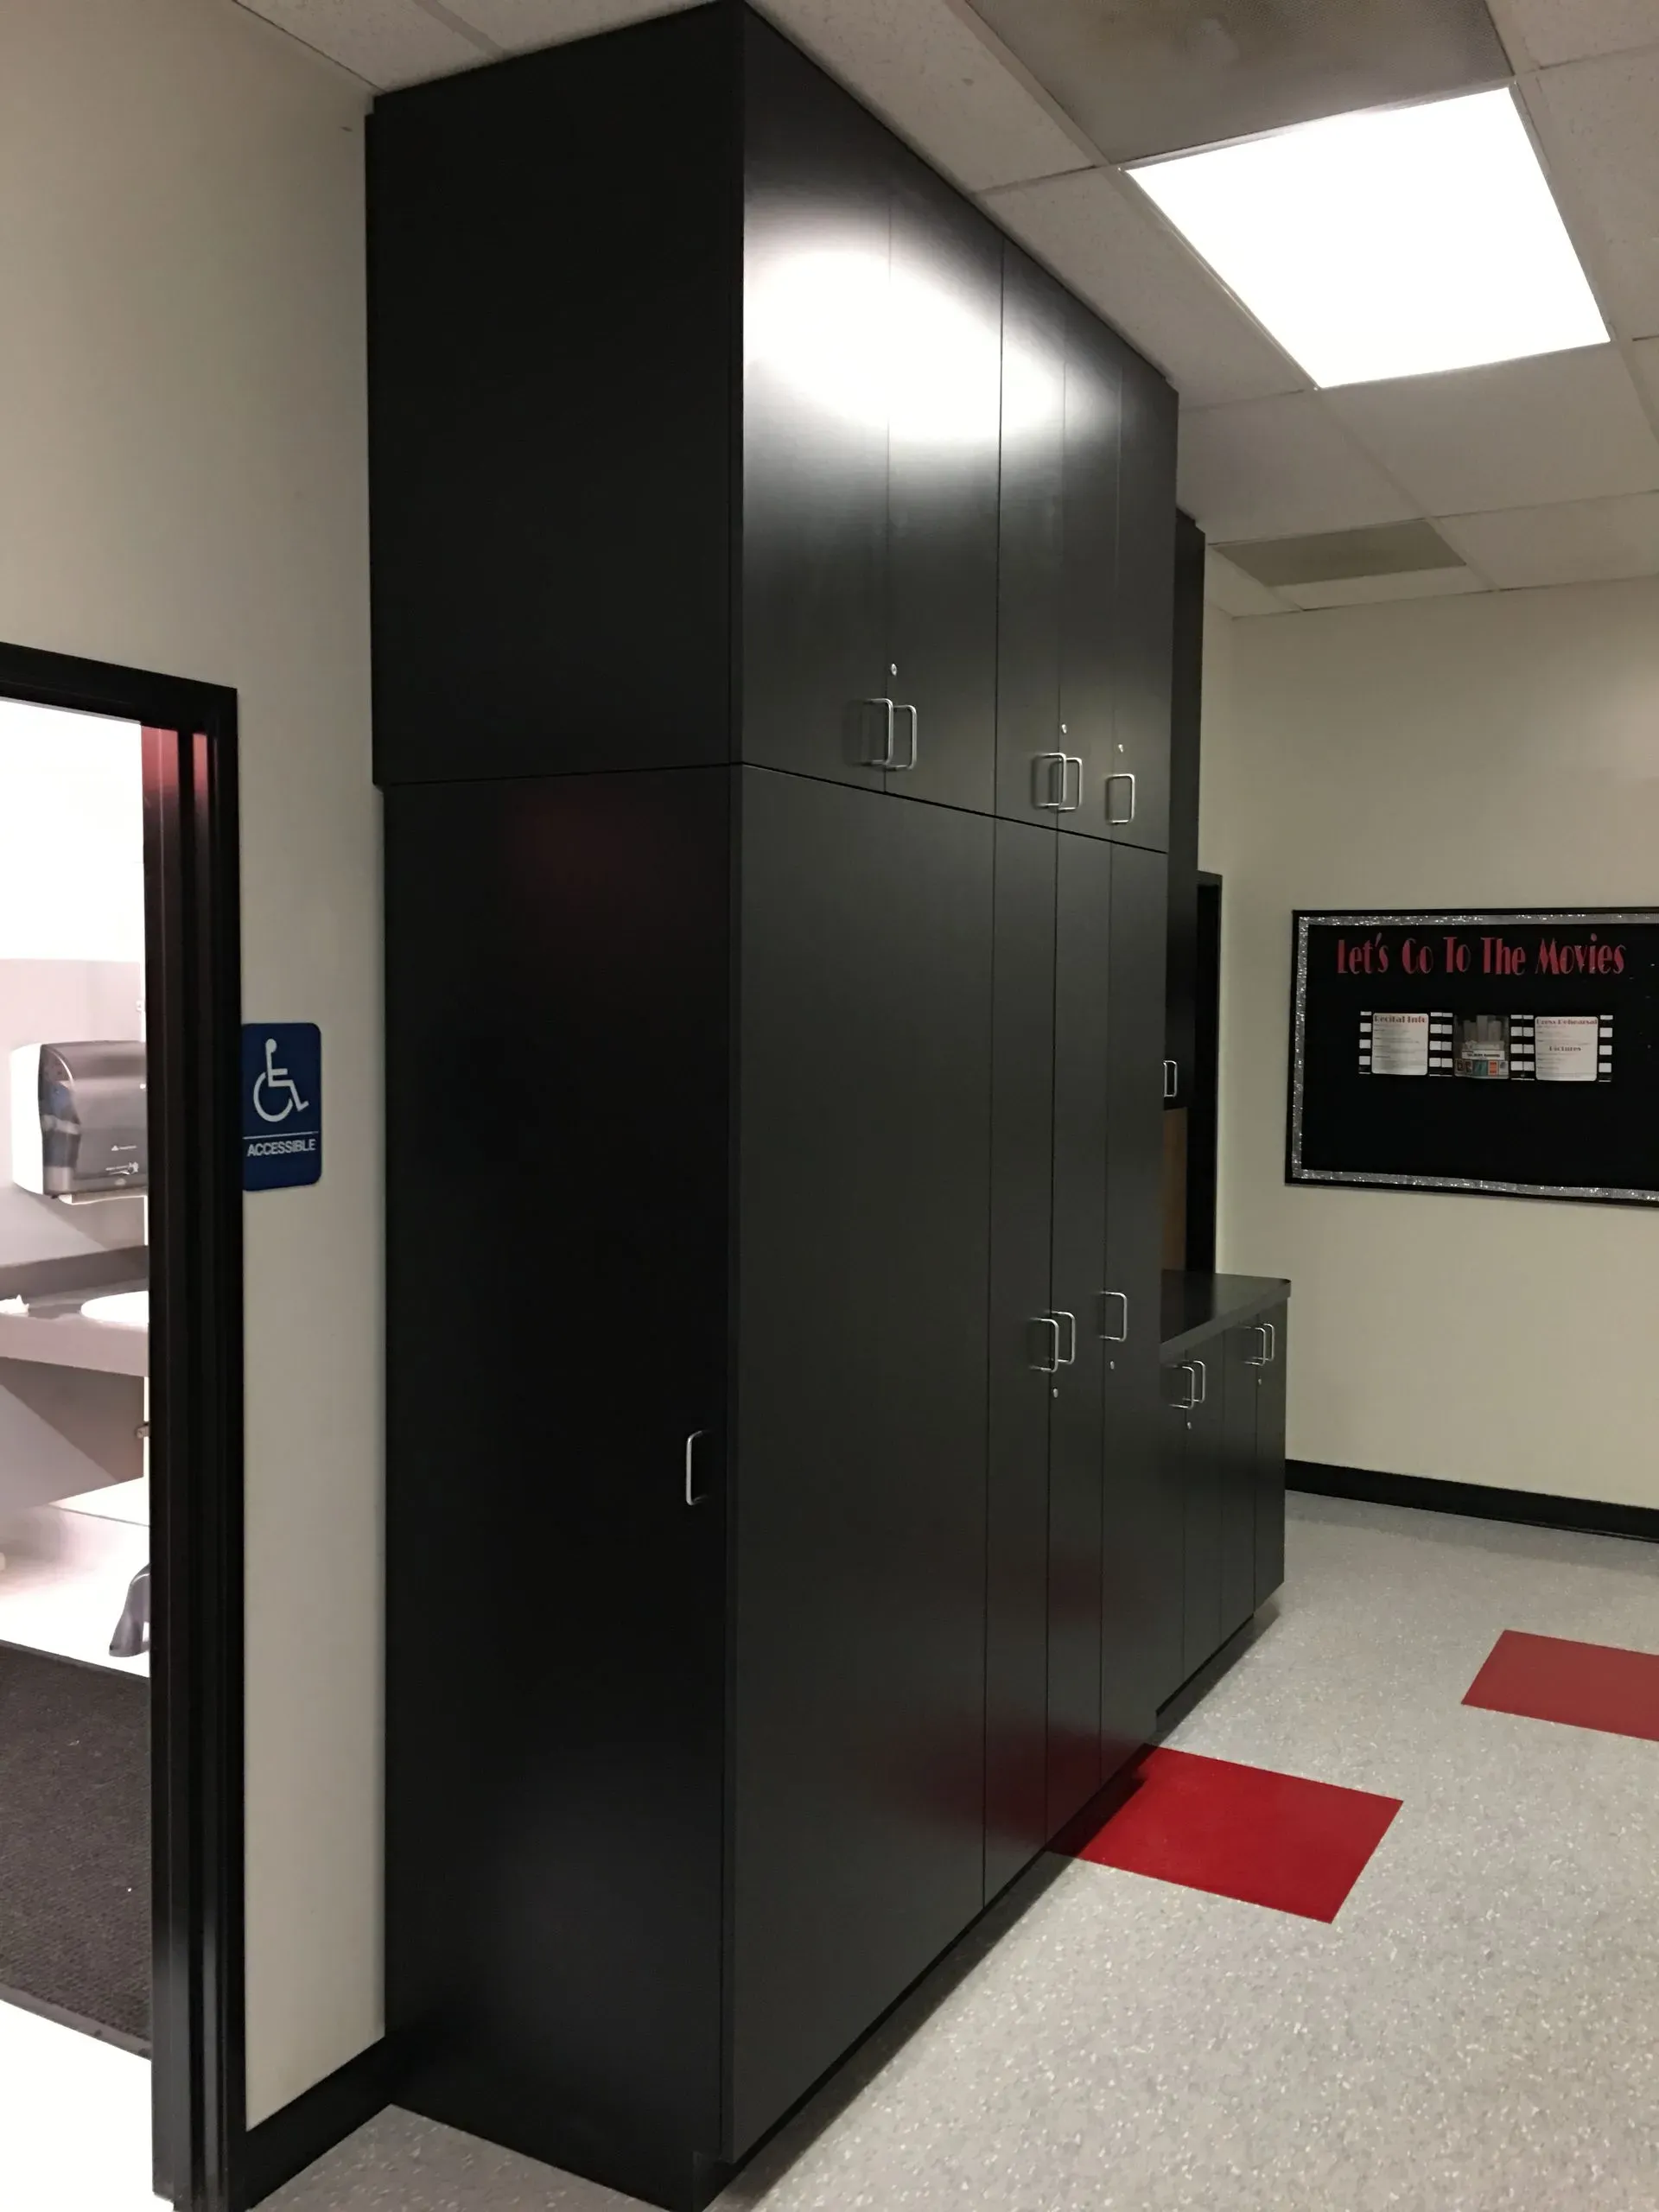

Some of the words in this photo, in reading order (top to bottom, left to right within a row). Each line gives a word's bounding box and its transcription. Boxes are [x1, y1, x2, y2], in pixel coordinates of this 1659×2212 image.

[1337, 932, 1389, 974] Let's
[1402, 938, 1433, 974] Go
[1443, 936, 1471, 973] To
[1480, 937, 1526, 975] The
[1535, 933, 1626, 975] Movies
[1374, 1015, 1405, 1024] Recital
[247, 1139, 316, 1157] ACCESSIBLE
